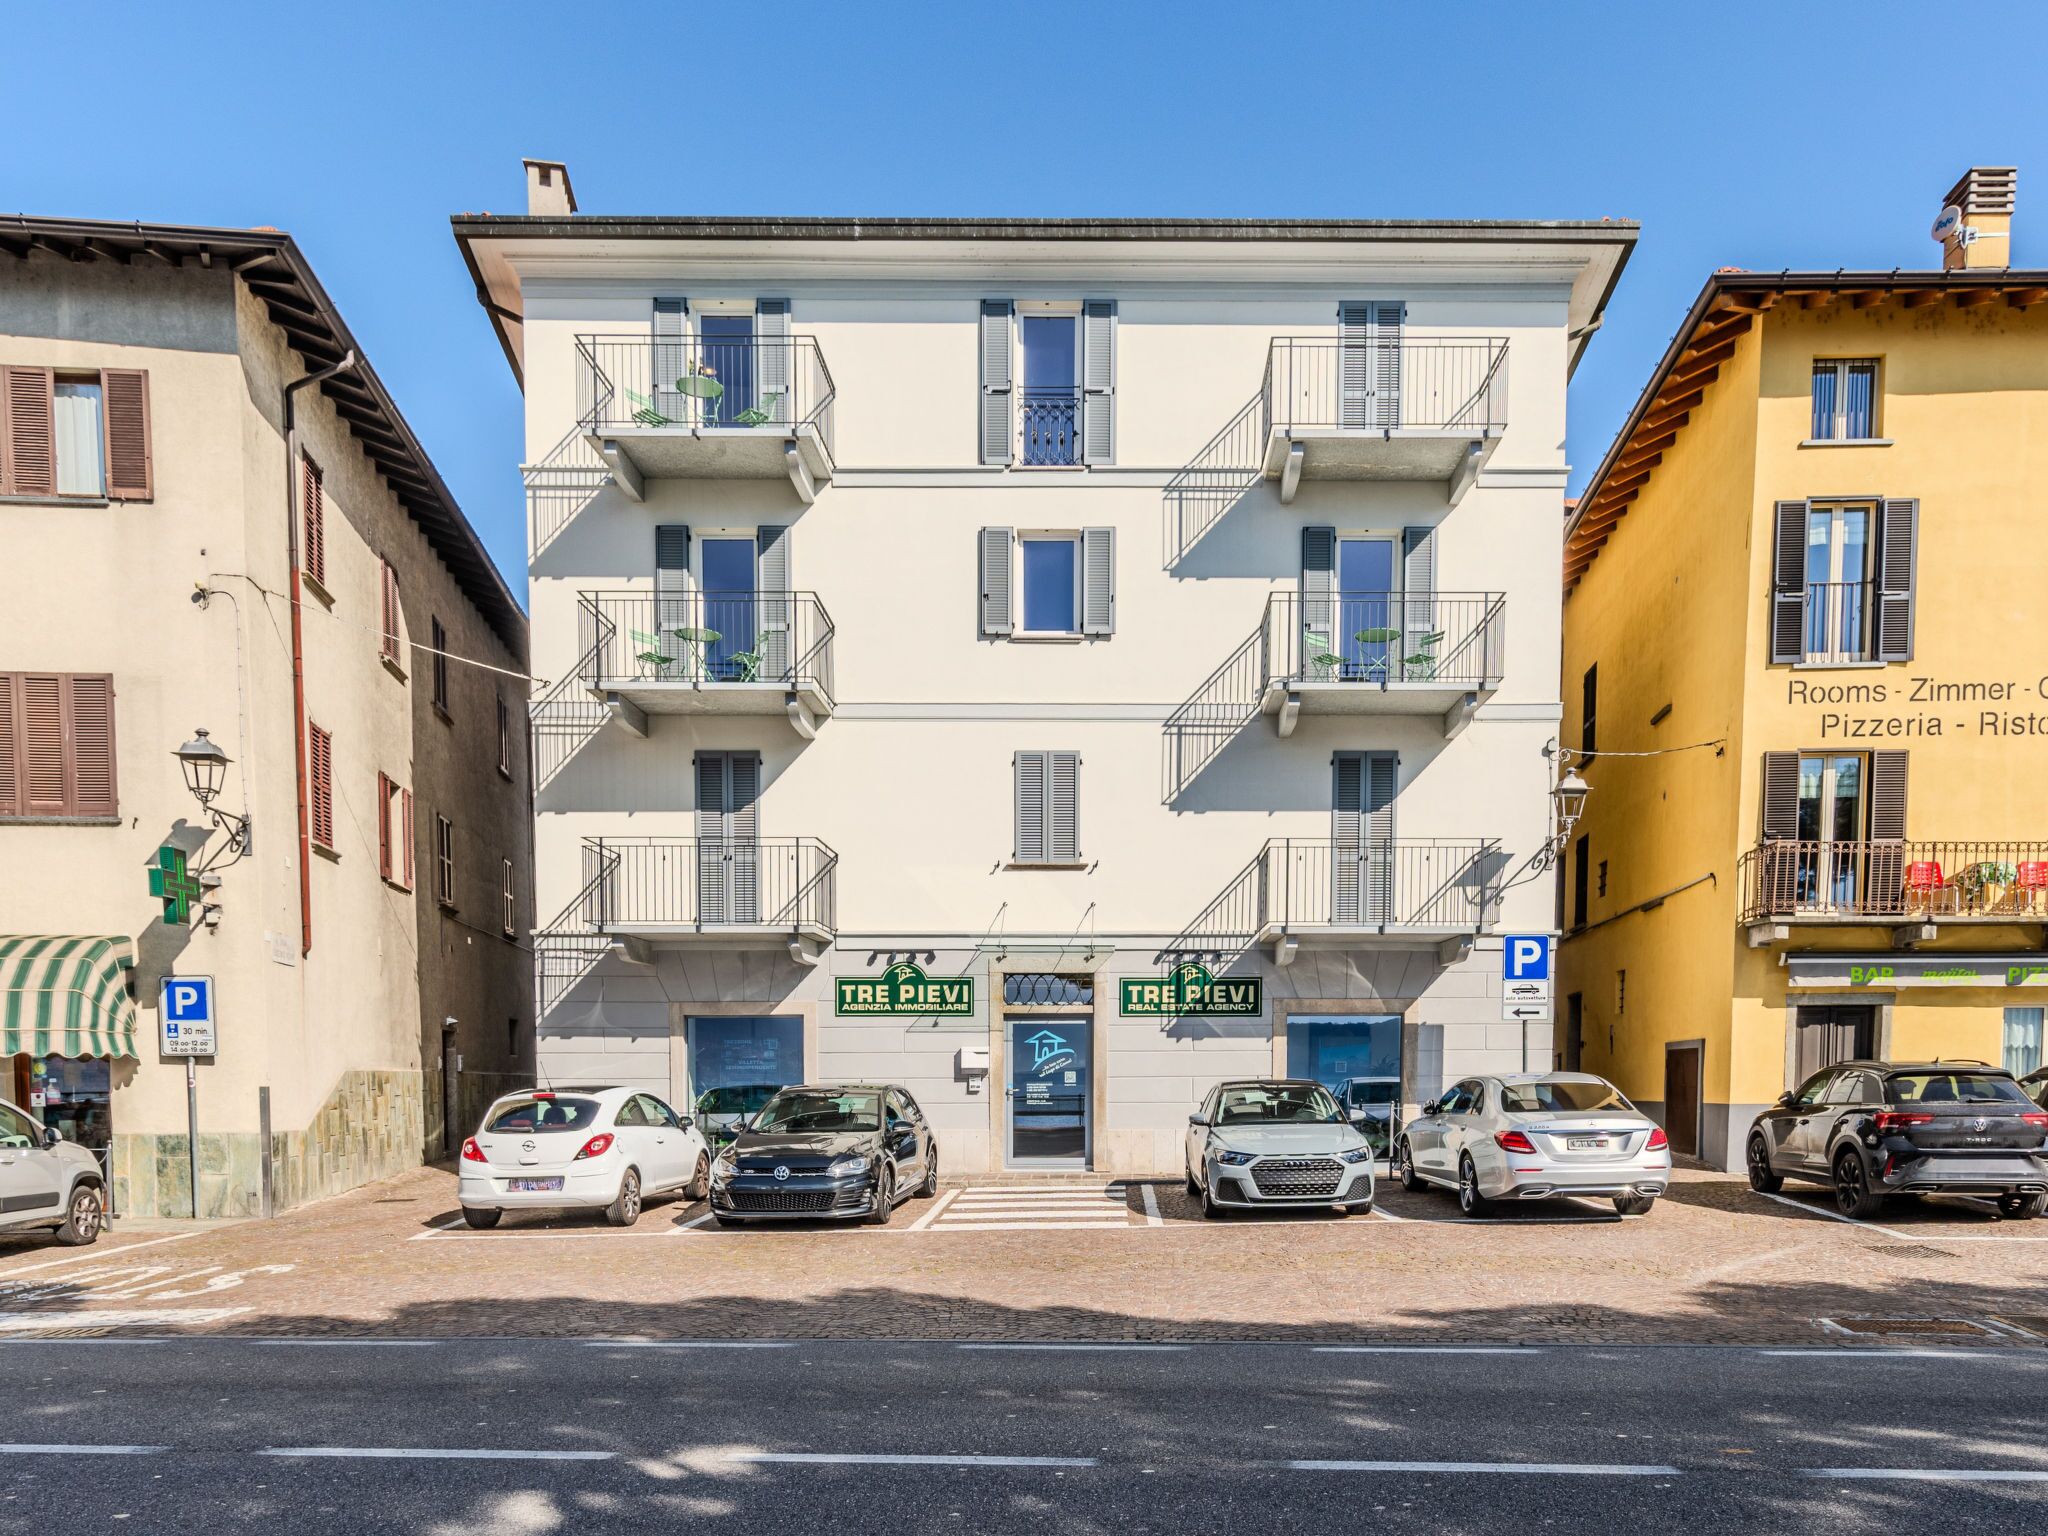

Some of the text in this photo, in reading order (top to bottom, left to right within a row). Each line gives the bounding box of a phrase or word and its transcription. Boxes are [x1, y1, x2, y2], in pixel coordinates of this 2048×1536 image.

[1788, 680, 1887, 704] Rooms
[1909, 677, 2016, 702] Zimmer
[1821, 712, 1943, 738] Pizzeria
[1514, 940, 1542, 976] P
[1850, 966, 1894, 983] BAR
[175, 987, 198, 1015] P
[841, 985, 968, 1003] TRE PIEVI
[1128, 985, 1254, 1003] TRE PIEVI
